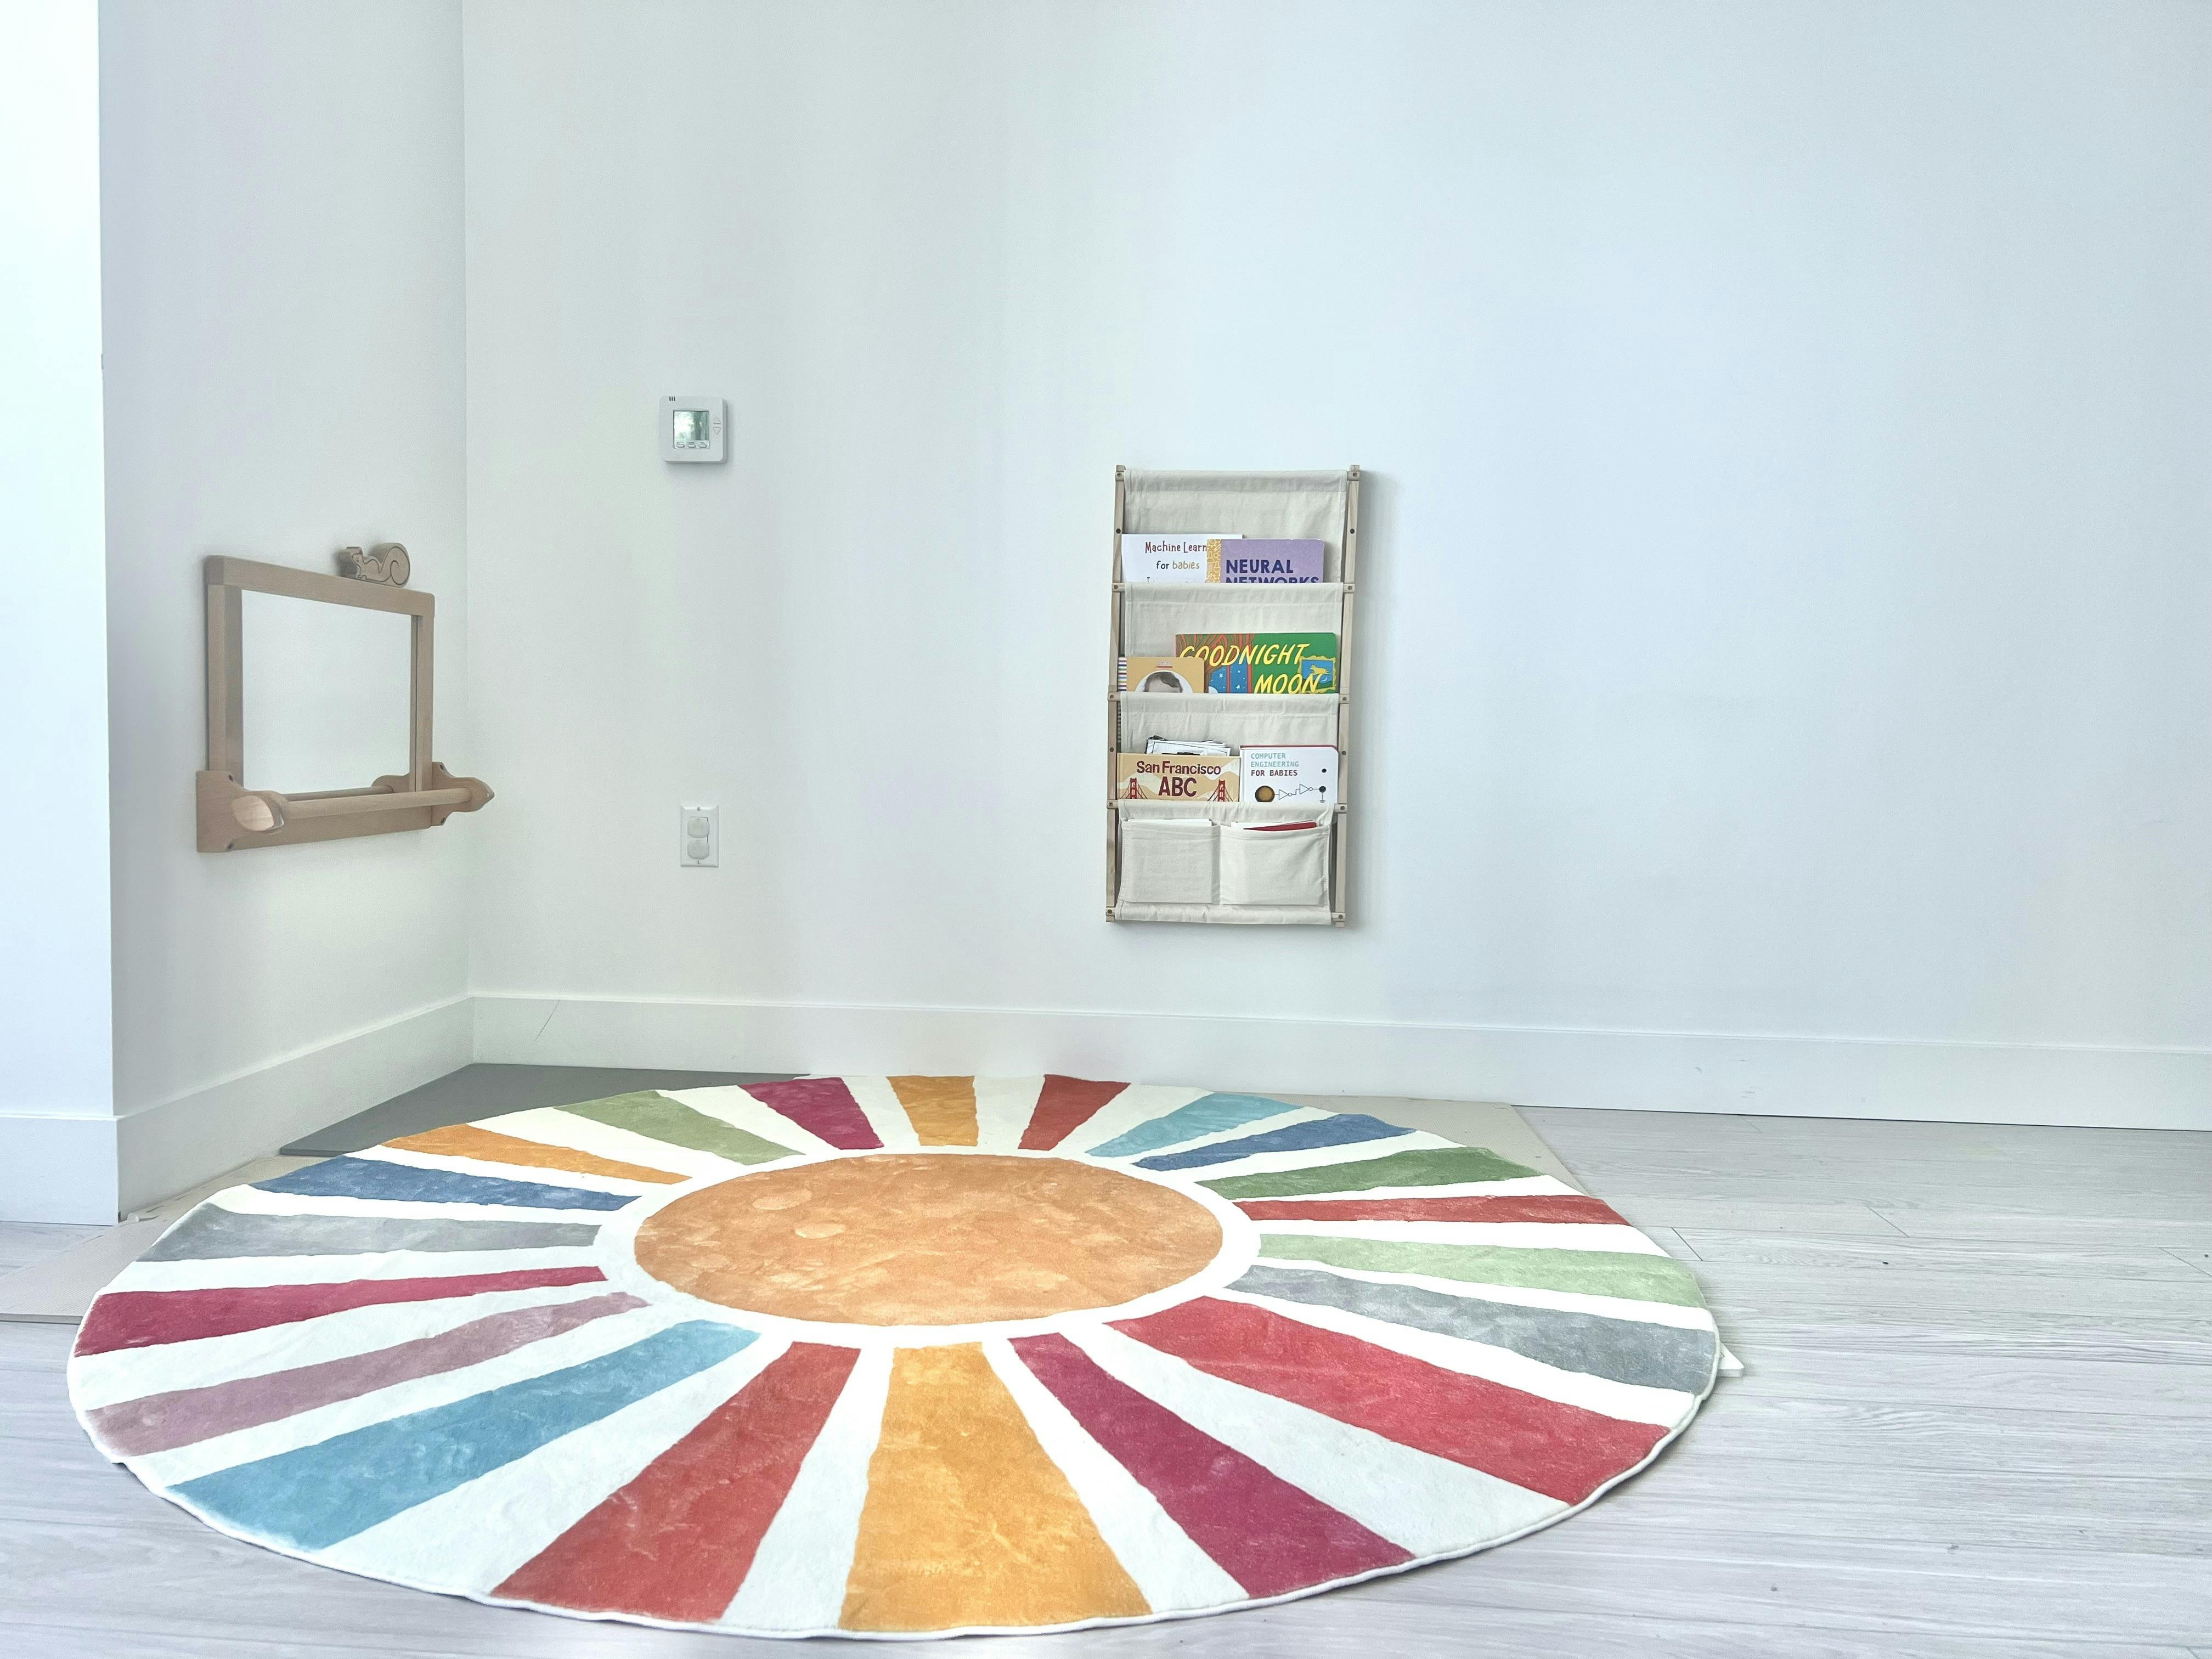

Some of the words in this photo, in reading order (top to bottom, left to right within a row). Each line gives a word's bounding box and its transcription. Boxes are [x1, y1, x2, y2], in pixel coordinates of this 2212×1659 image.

[1145, 540, 1181, 554] Machine
[1156, 560, 1169, 569] for
[1172, 561, 1200, 569] babies
[1226, 559, 1294, 574] NEURAL
[1180, 643, 1311, 667] GOODNIGHT
[1254, 673, 1323, 693] MOON
[1136, 760, 1160, 774] San
[1162, 760, 1221, 775] Francisco
[1158, 776, 1197, 797] ABC
